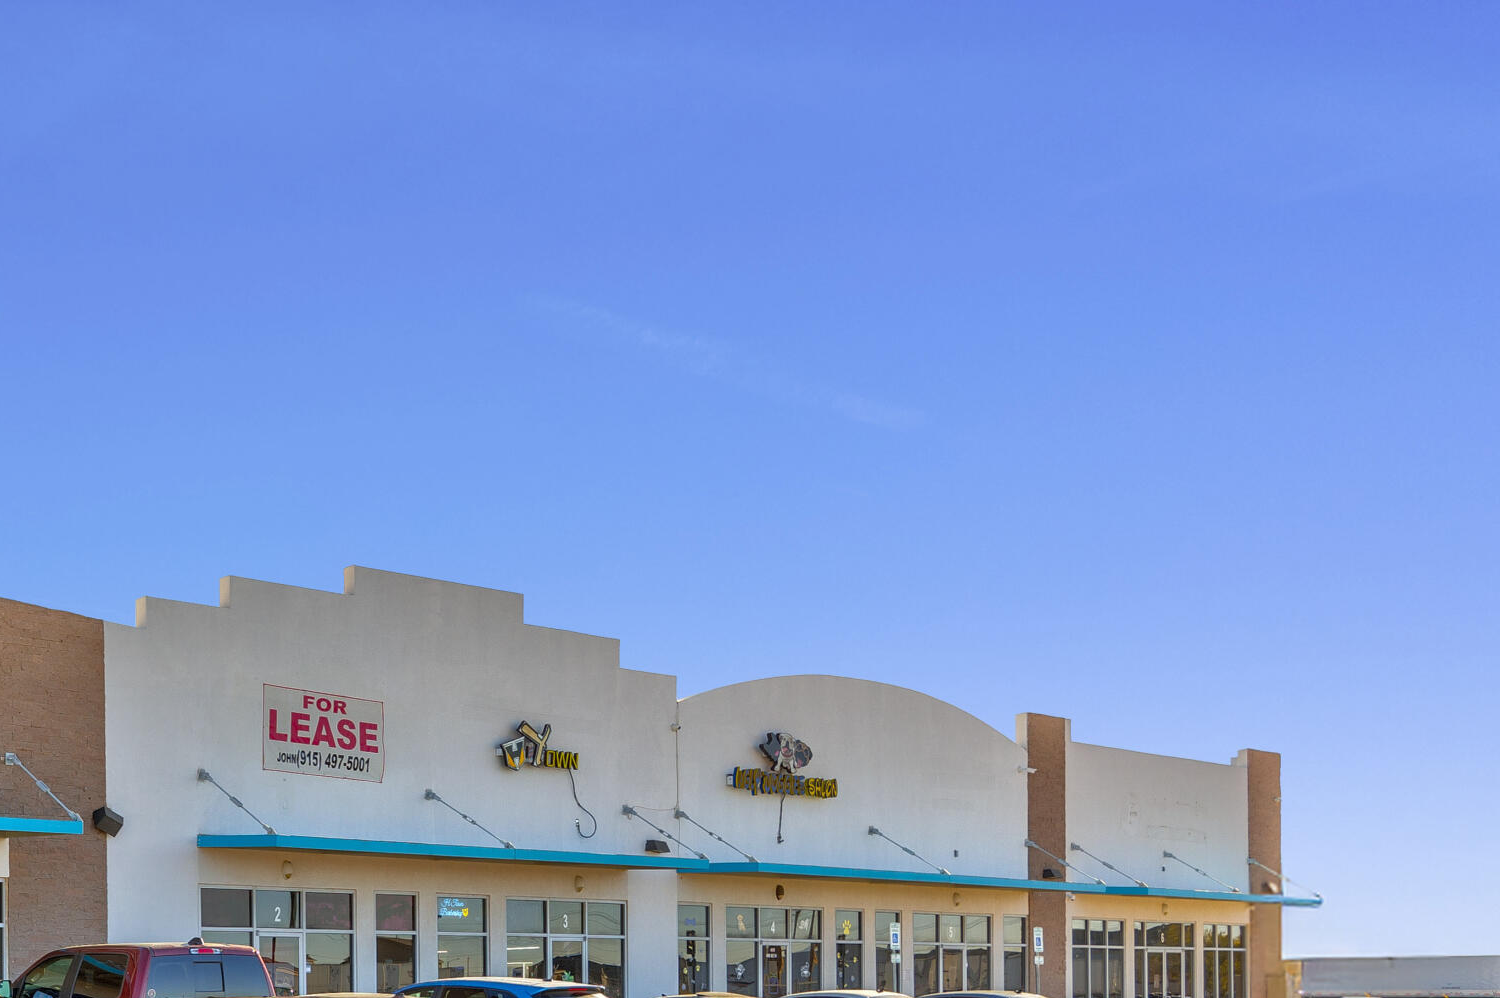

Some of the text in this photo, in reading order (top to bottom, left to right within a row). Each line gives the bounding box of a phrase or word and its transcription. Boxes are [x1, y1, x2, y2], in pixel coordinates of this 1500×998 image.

[303, 695, 347, 714] FOR
[269, 709, 379, 753] LEASE
[325, 753, 370, 772] 497-5001
[274, 906, 281, 922] 2
[563, 914, 568, 928] 3
[770, 921, 775, 934] 4
[949, 926, 954, 938] 5
[1161, 932, 1165, 943] 6
